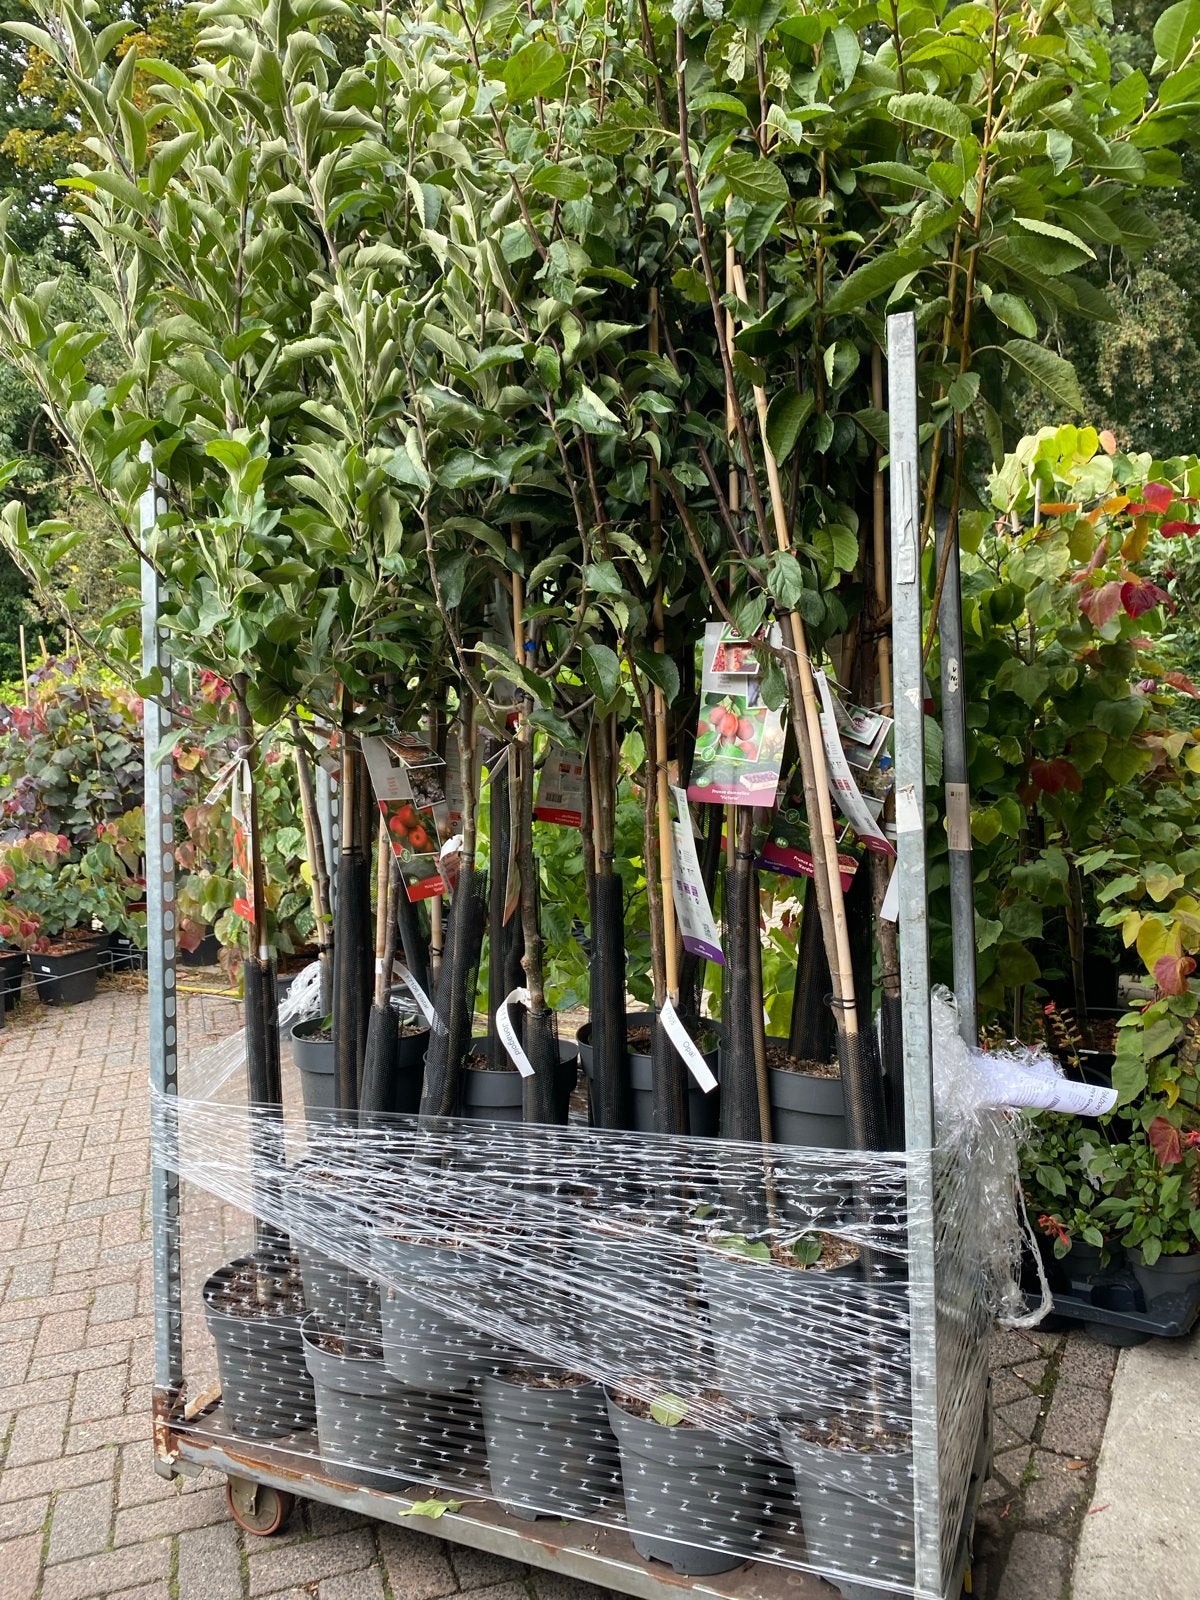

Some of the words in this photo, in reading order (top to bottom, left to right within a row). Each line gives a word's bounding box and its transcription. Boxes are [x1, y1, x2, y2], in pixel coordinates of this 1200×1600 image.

[793, 855, 808, 867] Prunus
[502, 1022, 522, 1056] Jonagold
[682, 1040, 696, 1058] Opal
